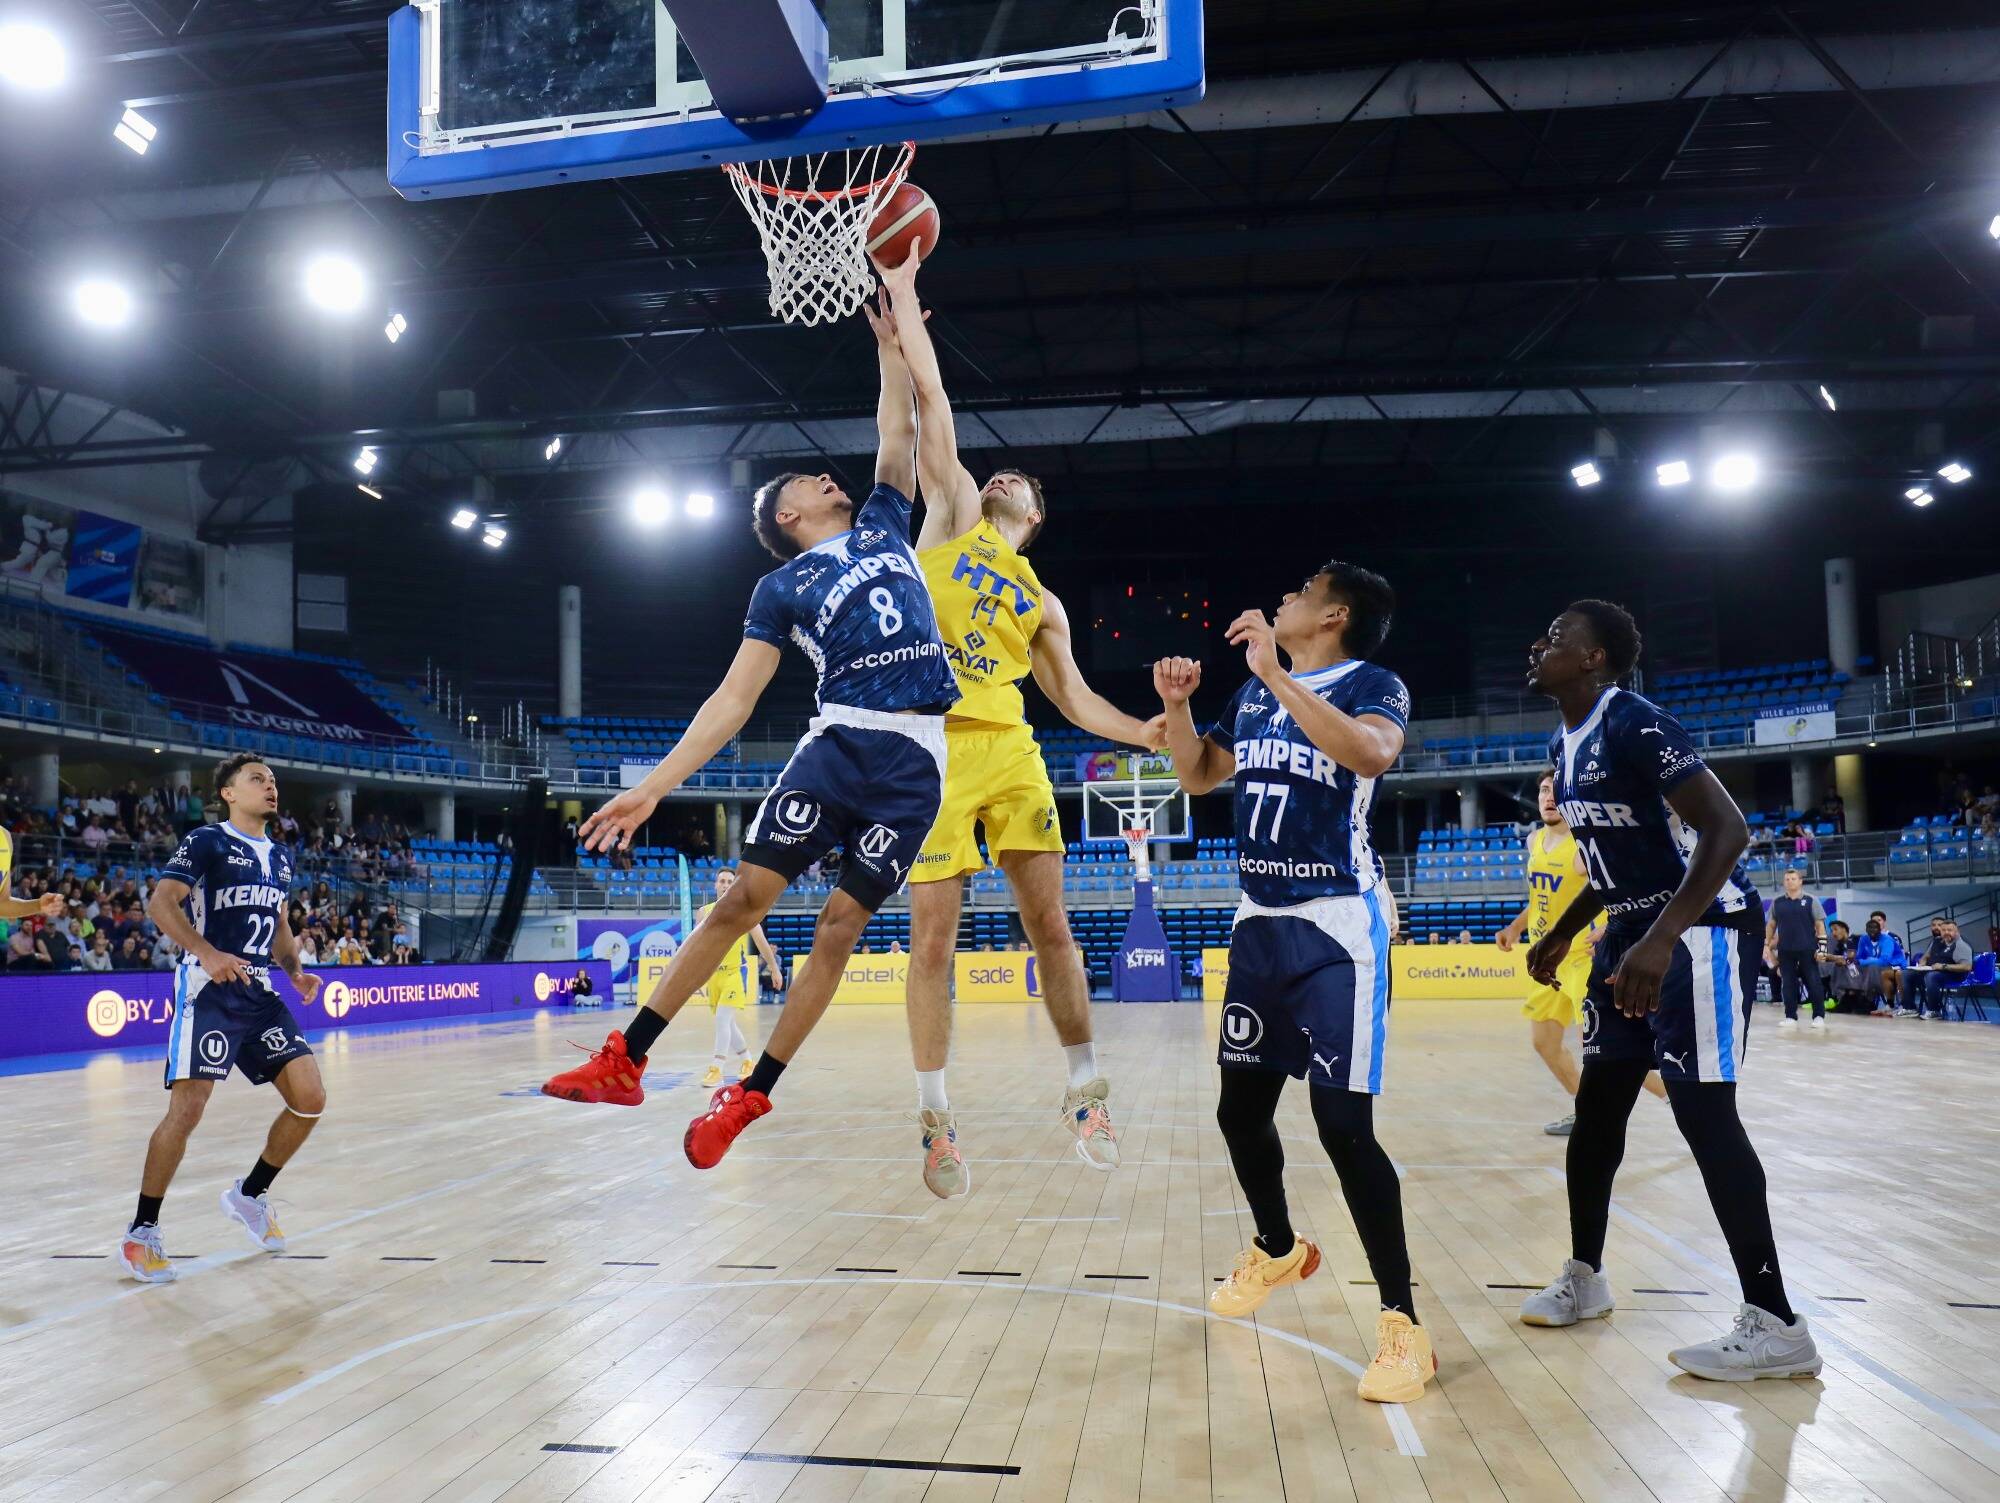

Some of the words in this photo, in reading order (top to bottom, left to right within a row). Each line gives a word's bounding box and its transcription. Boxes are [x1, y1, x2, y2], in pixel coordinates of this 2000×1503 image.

[857, 529, 888, 550] inizys
[951, 552, 1037, 617] HTV
[868, 586, 903, 638] 8
[970, 592, 1000, 626] 14
[1241, 702, 1268, 715] SOFT
[1760, 708, 1784, 718] VILLE
[1795, 703, 1829, 714] TOULON
[1234, 738, 1339, 790] EMPER
[1578, 770, 1607, 782] inizys
[1245, 781, 1290, 845] 77
[1556, 799, 1641, 827] MPER
[227, 855, 254, 868] SOFT
[1239, 852, 1337, 878] écomiam
[242, 913, 275, 956] 22
[844, 967, 905, 982] notek
[968, 965, 1015, 984] sade
[1407, 966, 1449, 979] Crédit
[1467, 966, 1515, 979] Mutuel
[350, 984, 425, 1008] BIJOUTERIE
[428, 982, 480, 1000] LEMOINE
[199, 1064, 228, 1076] FINISTÈRE
